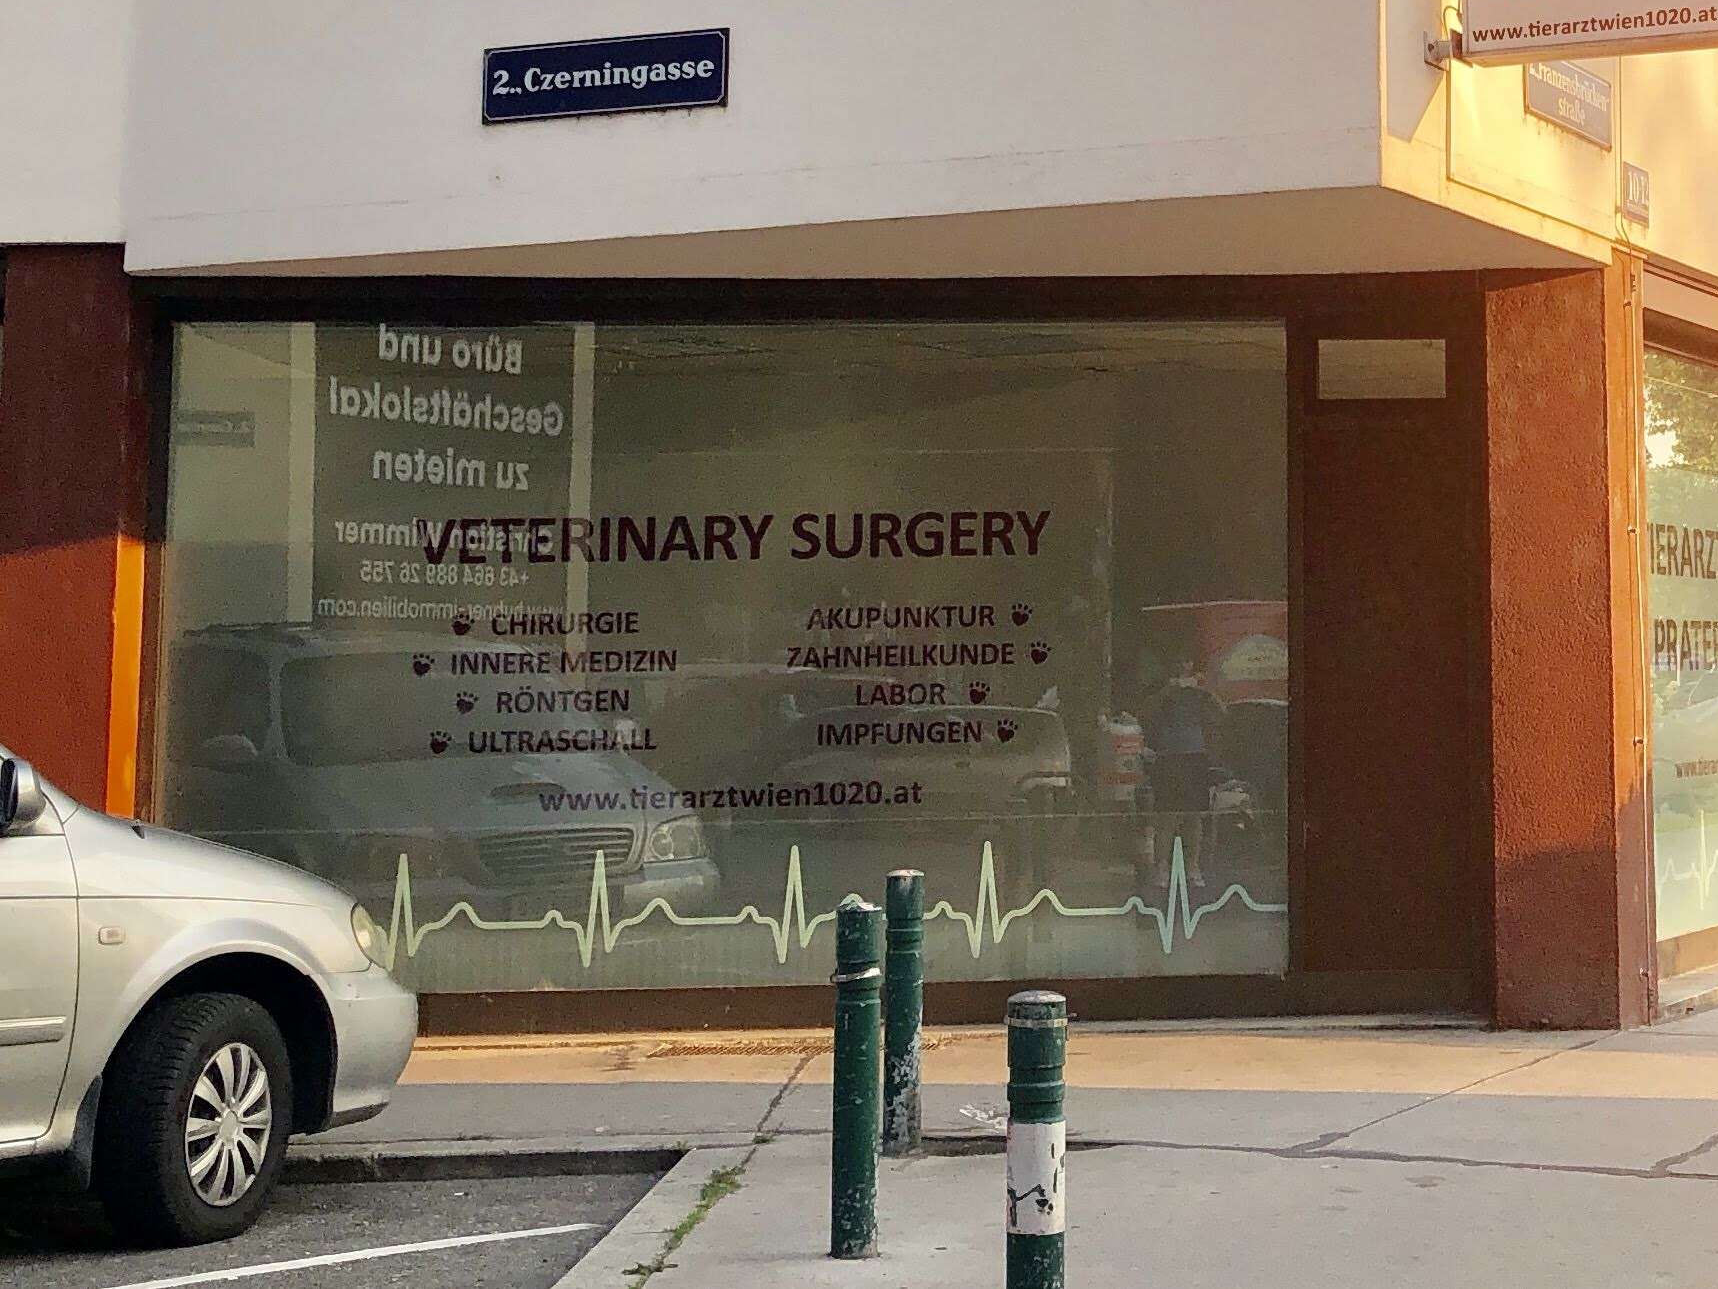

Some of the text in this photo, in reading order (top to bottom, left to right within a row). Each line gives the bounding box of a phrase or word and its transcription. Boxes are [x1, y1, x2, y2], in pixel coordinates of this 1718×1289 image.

[1472, 5, 1718, 42] www.tierarztwien1020.at
[524, 60, 715, 90] Czerningasse
[416, 510, 1051, 565] VETERINARY SURGERY
[490, 611, 640, 636] CHIRURGIE
[806, 604, 996, 631] AKUPUNKTUR
[451, 648, 679, 676] INNERE MEDIZIN
[786, 642, 1015, 670] ZAHNHEILKUNDE
[496, 685, 630, 714] RÖNTGEN
[855, 683, 946, 707] LABOR
[468, 727, 658, 754] ULTRASCHALL
[817, 721, 984, 748] IMPFUNGEN
[538, 780, 924, 813] www.tierarztwien1020.at
